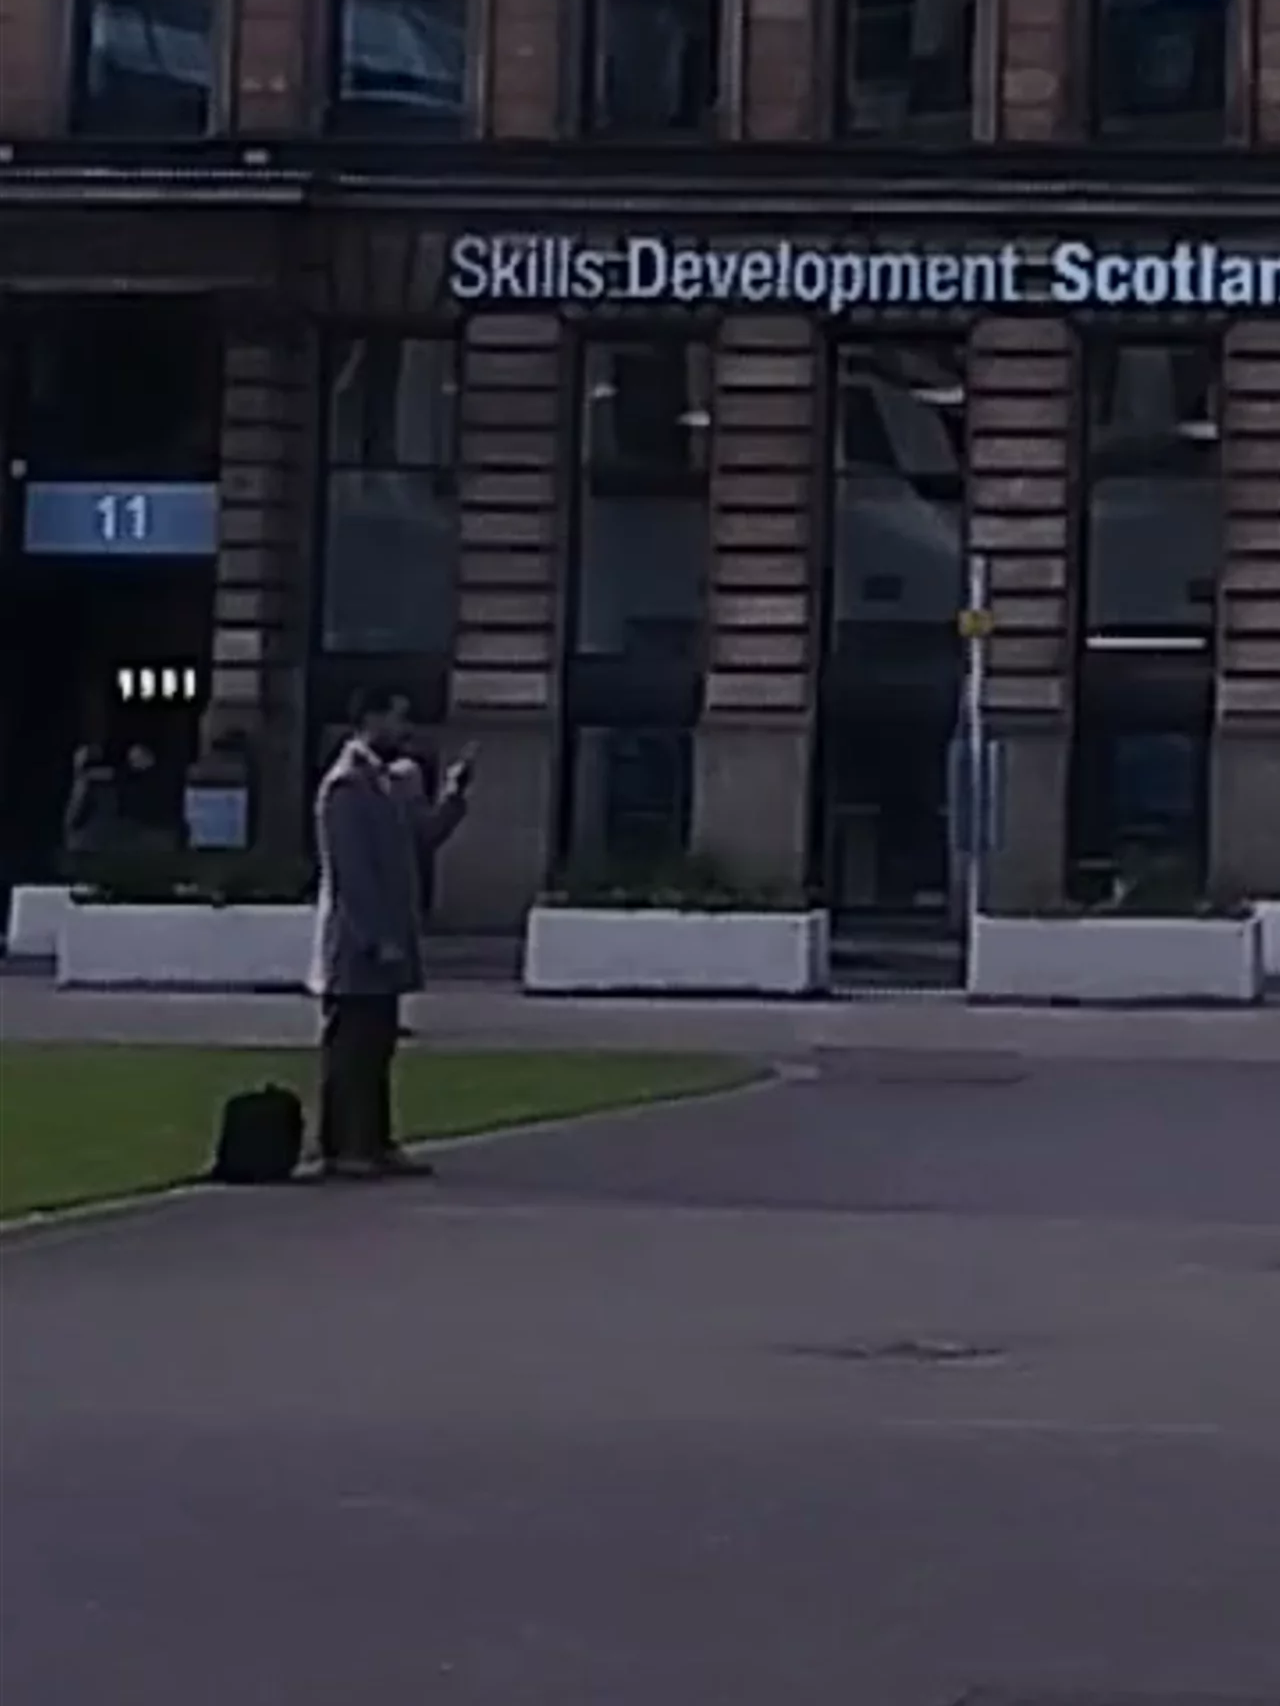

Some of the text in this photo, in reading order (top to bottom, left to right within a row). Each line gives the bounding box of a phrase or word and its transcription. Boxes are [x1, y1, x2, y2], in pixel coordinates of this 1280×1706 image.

[450, 234, 603, 299] Skills
[626, 237, 1022, 314] Development
[95, 493, 148, 540] 11
